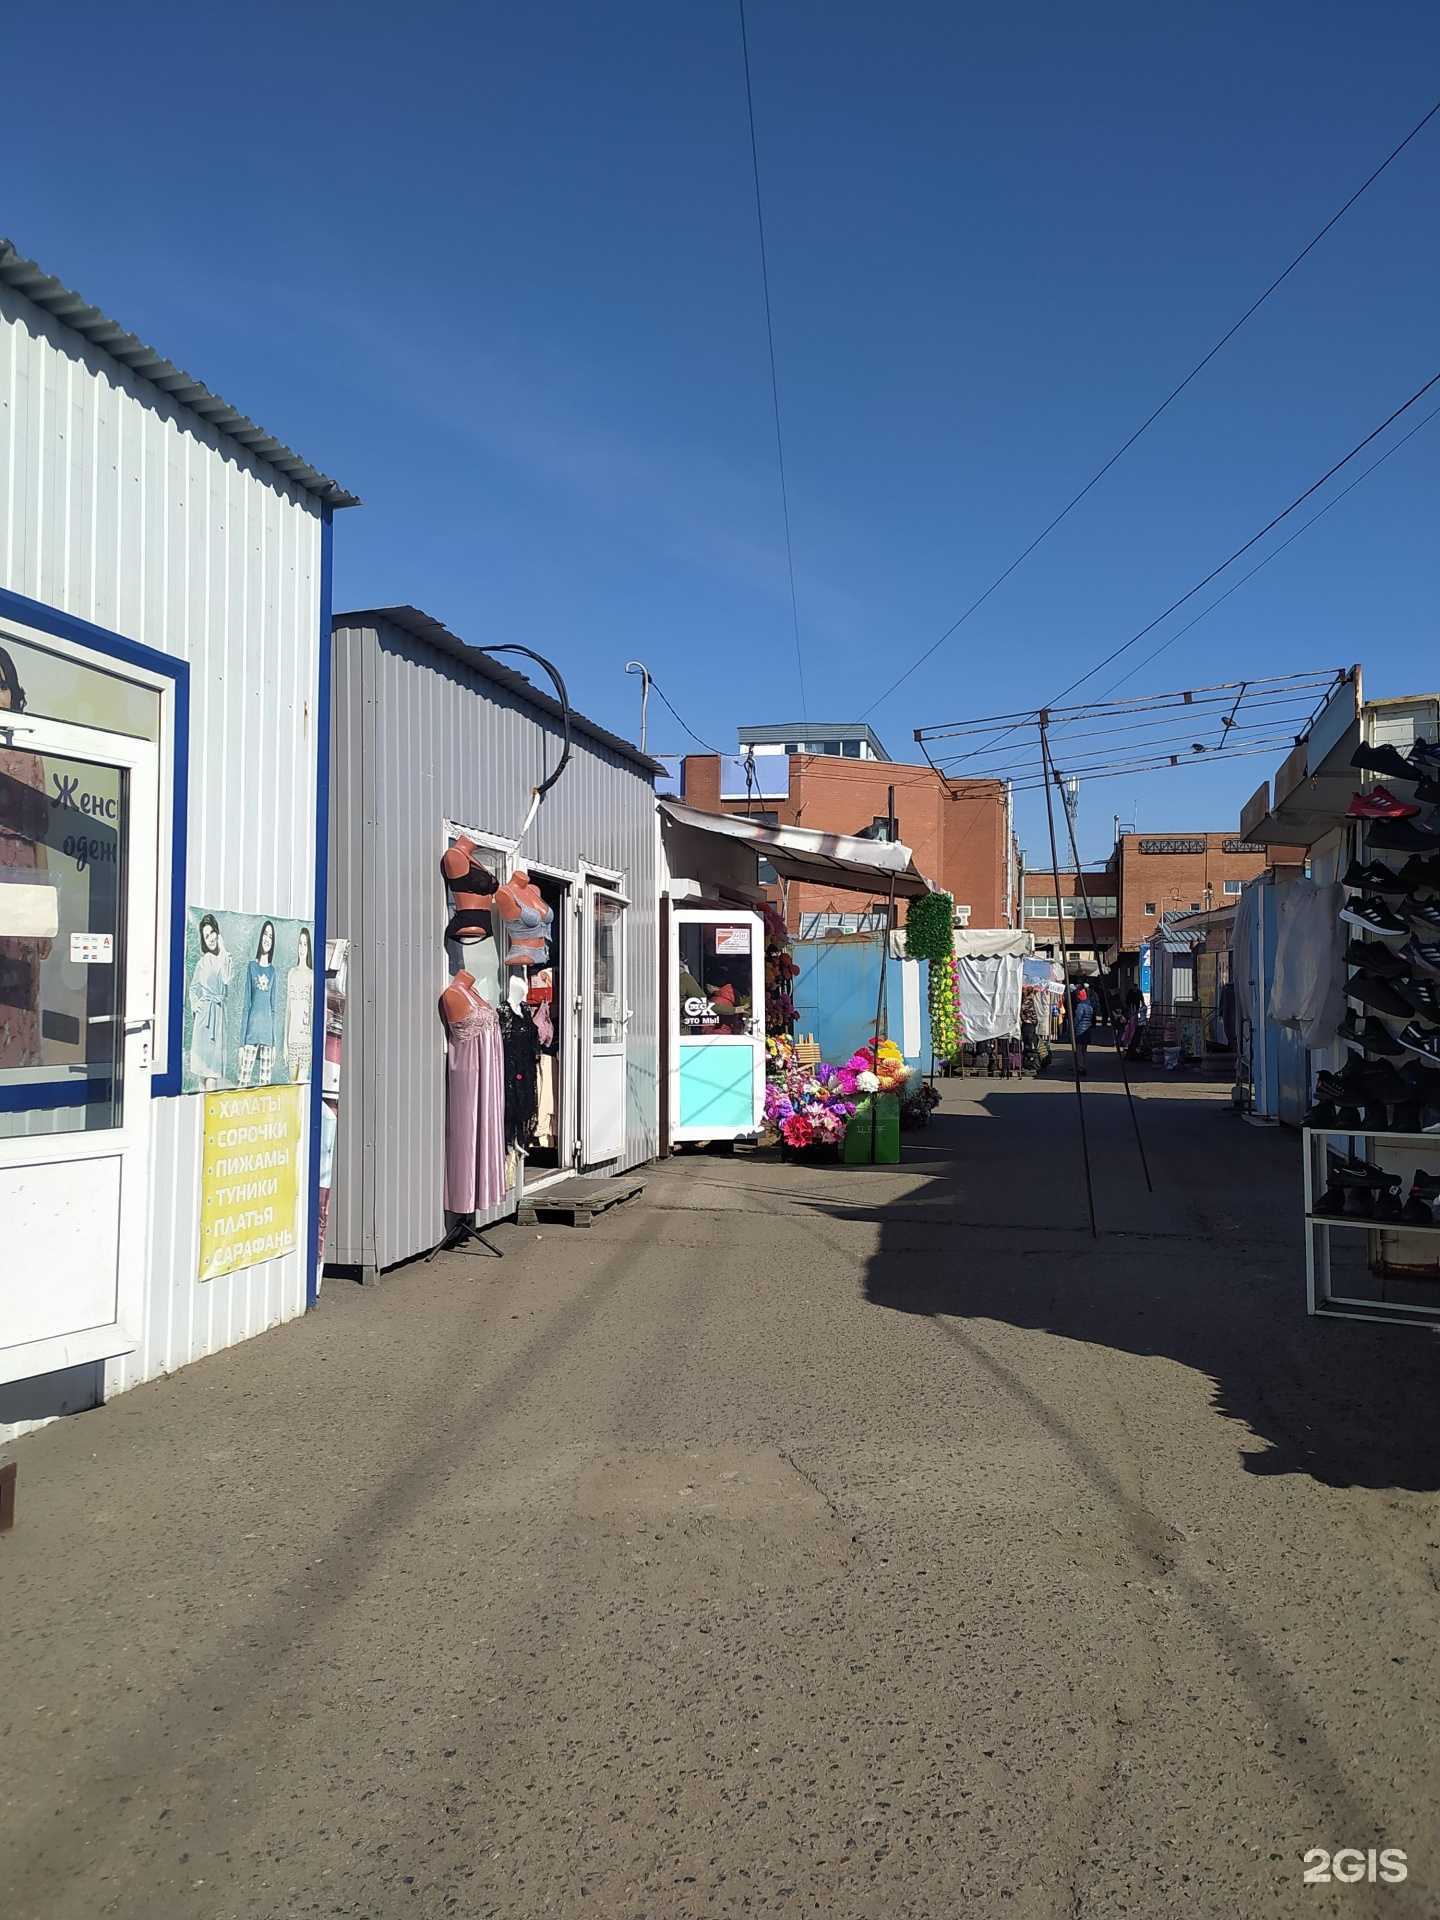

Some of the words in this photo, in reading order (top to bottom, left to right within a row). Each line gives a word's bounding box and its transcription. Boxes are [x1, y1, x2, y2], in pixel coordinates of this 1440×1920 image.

[51, 773, 119, 820] Женс
[702, 1016, 720, 1024] мы!
[219, 1095, 281, 1119] ХАЛАТЫ
[217, 1122, 288, 1148] СОРОЧКИ
[216, 1148, 289, 1177] ПИЖАМЫ
[215, 1178, 278, 1207] ТУНИКИ
[213, 1206, 274, 1238] ПЛАТЬЯ
